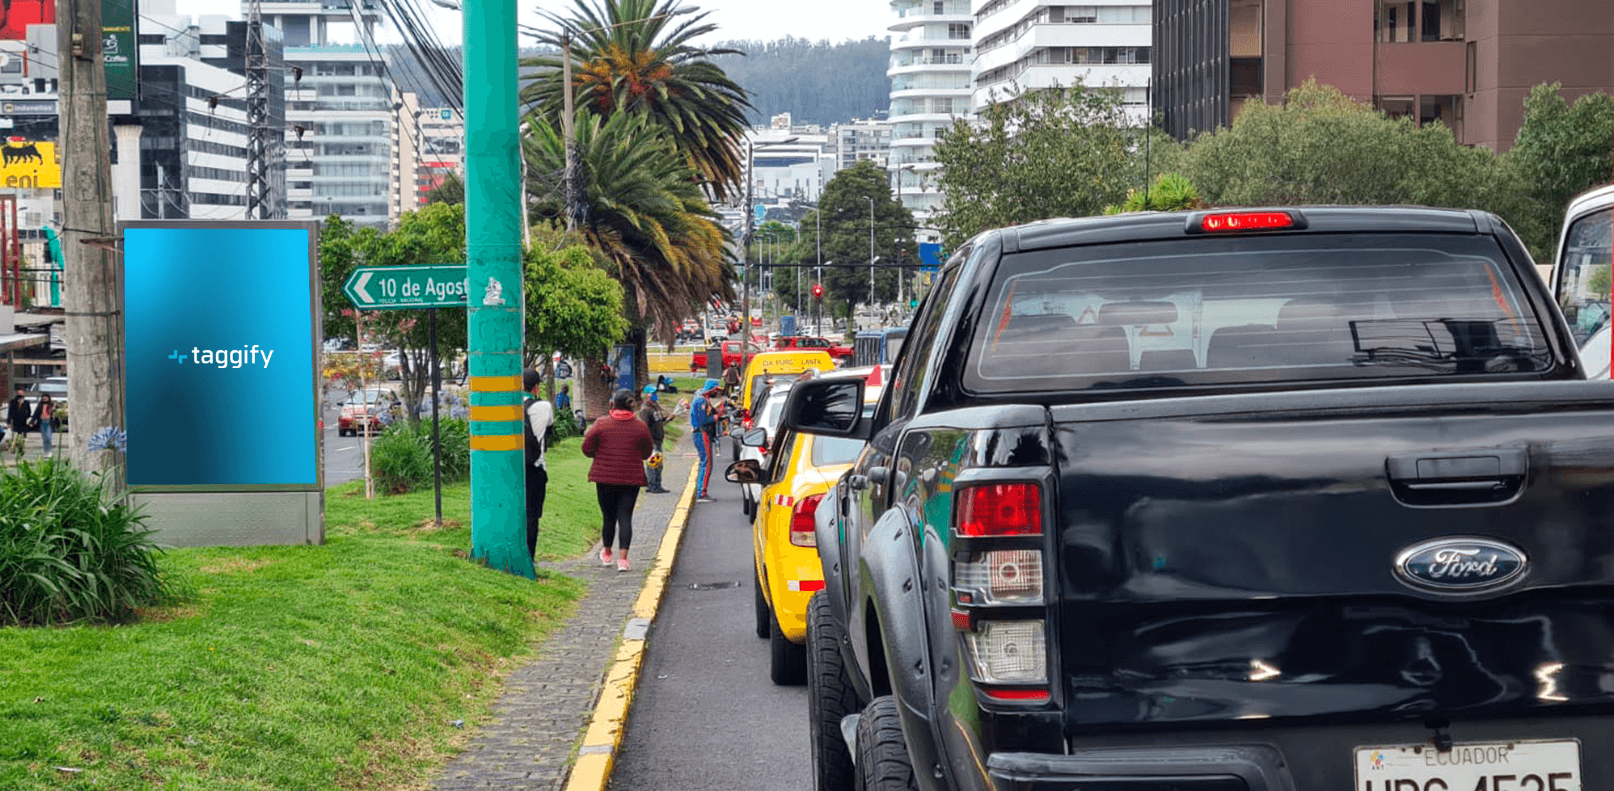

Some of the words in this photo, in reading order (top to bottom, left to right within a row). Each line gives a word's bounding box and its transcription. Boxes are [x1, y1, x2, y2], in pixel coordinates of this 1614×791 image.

[5, 169, 38, 188] eni
[379, 278, 397, 297] 10
[402, 276, 420, 297] de
[425, 276, 468, 301] Agost
[191, 345, 274, 369] taggify
[1428, 548, 1499, 578] Ford
[1424, 745, 1510, 767] ECUADOR
